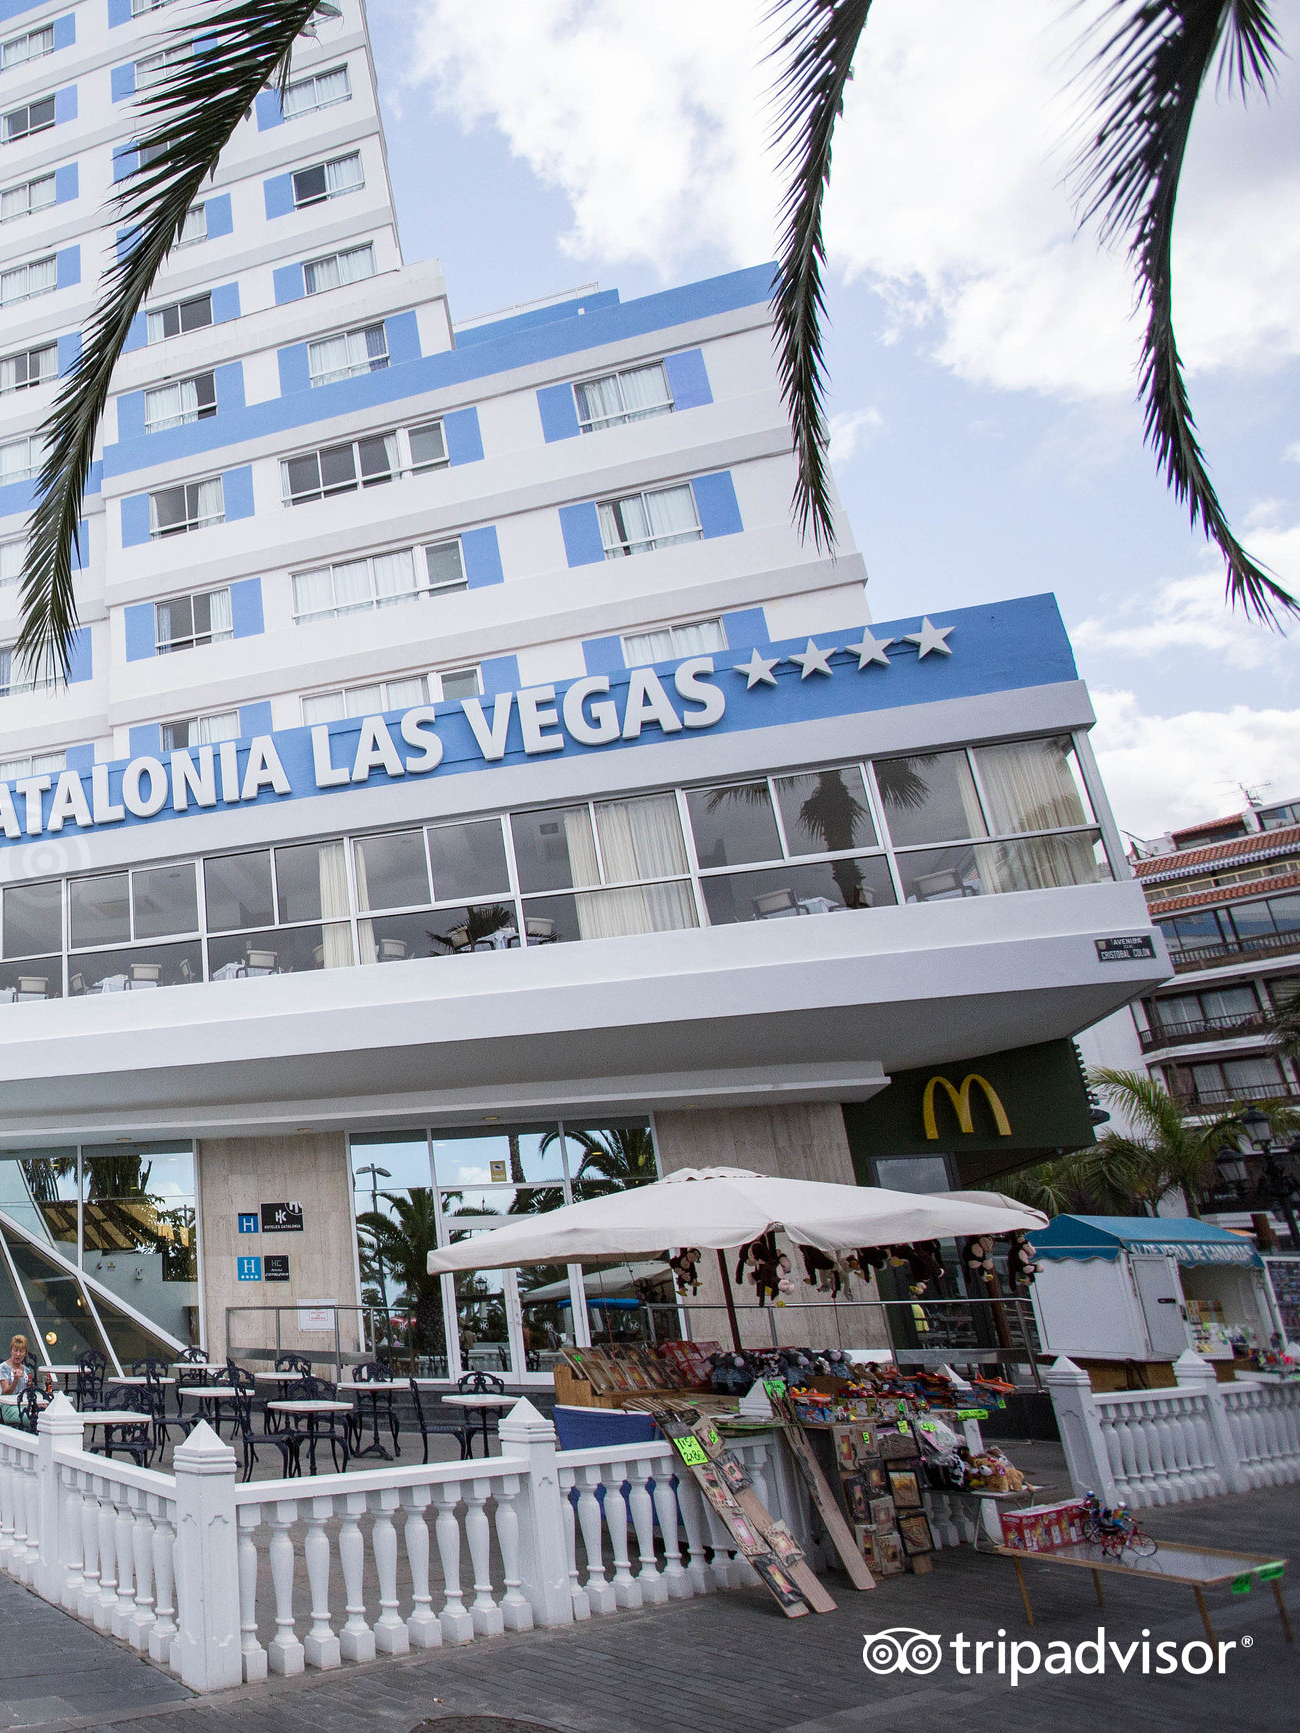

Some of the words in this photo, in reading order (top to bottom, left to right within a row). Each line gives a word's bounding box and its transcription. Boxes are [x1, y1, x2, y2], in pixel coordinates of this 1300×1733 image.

[311, 706, 444, 788] LAS
[460, 657, 726, 762] VEGAS
[243, 1218, 254, 1232] H
[1186, 1244, 1207, 1260] DE
[1201, 1245, 1254, 1261] CANARIAS
[243, 1259, 256, 1273] H
